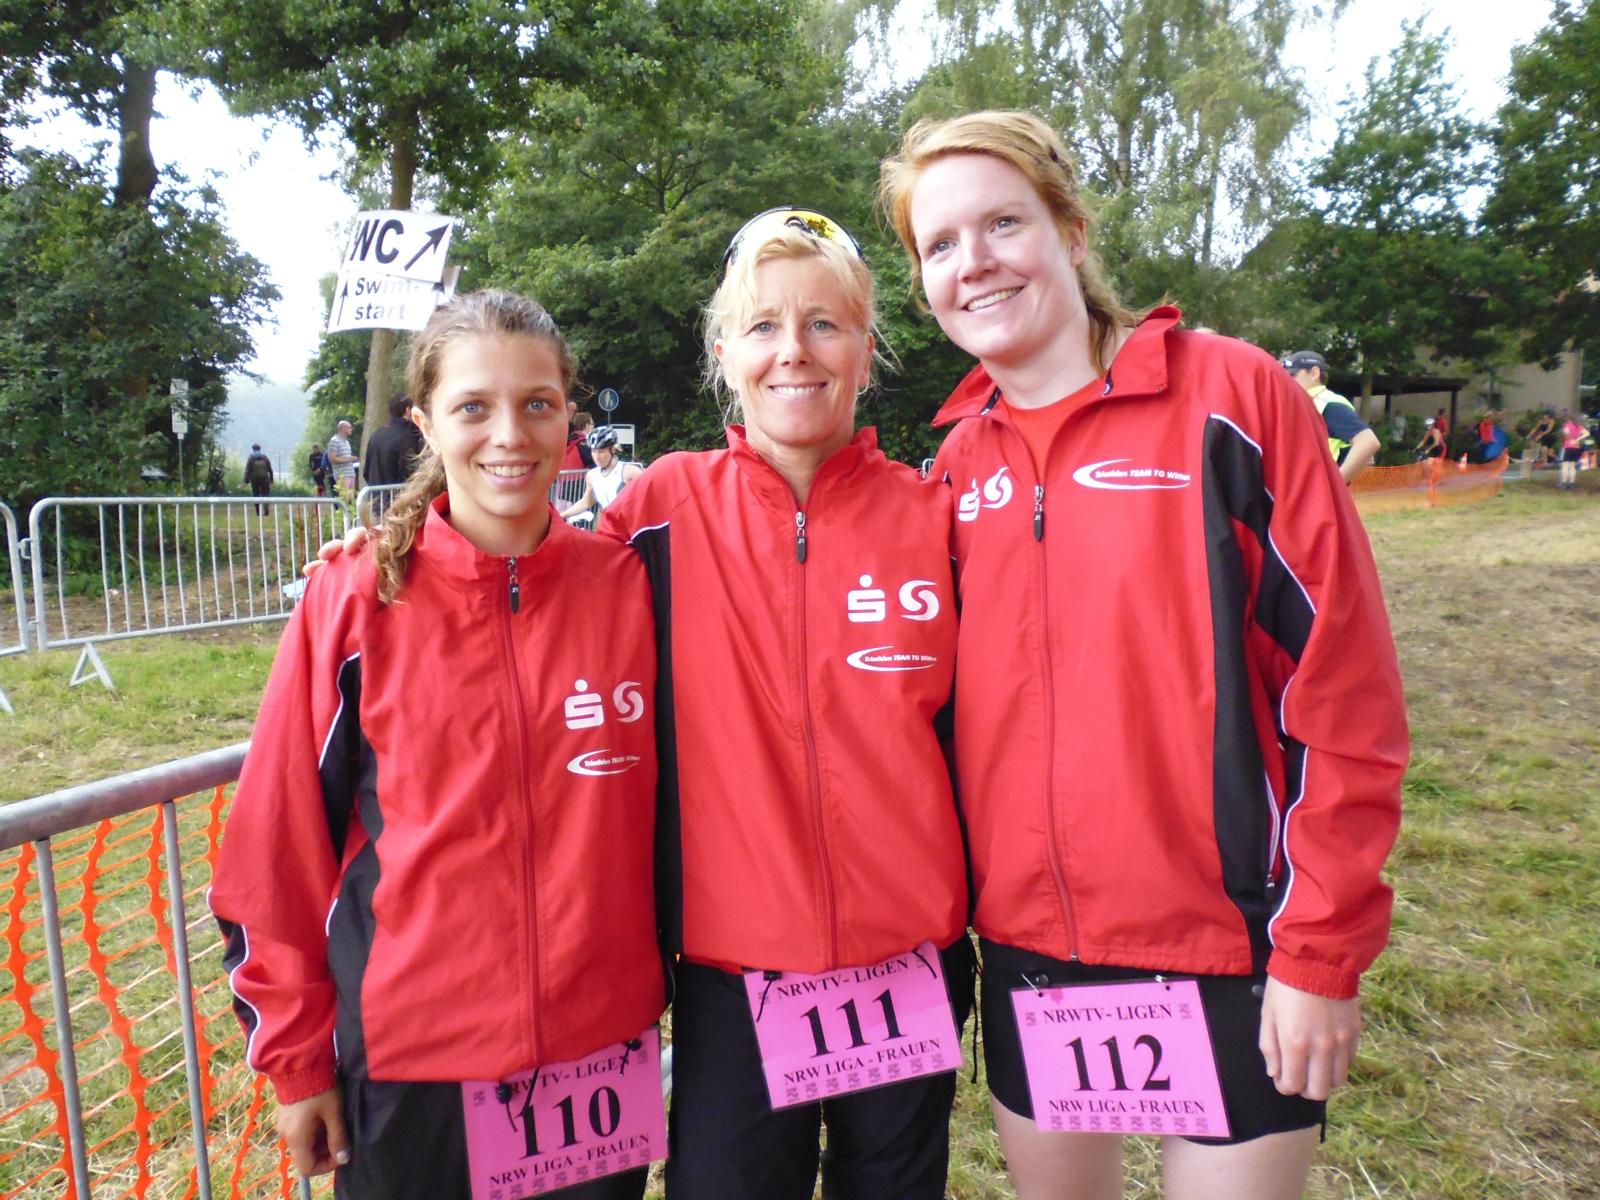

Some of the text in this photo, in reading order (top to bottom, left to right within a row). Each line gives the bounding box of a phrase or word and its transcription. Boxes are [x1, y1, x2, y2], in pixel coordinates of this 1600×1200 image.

[354, 301, 407, 321] start
[1095, 469, 1128, 478] Triathlon
[1130, 469, 1152, 477] TEAM
[1153, 469, 1165, 477] TO
[855, 958, 910, 984] LIGEN
[800, 988, 908, 1059] 111
[1116, 1004, 1173, 1020] LIGEN
[783, 1065, 822, 1085] NRW
[826, 1057, 865, 1075] LIGA
[877, 1038, 941, 1063] FRAUEN
[1064, 1034, 1171, 1092] 112
[514, 1086, 621, 1160] 110
[1048, 1099, 1085, 1113] NRW
[1088, 1100, 1127, 1113] LIGA
[1140, 1100, 1205, 1115] FRAUEN
[490, 1169, 529, 1185] NRW
[534, 1156, 573, 1176] LIGA
[587, 1134, 650, 1161] FRAUEN
